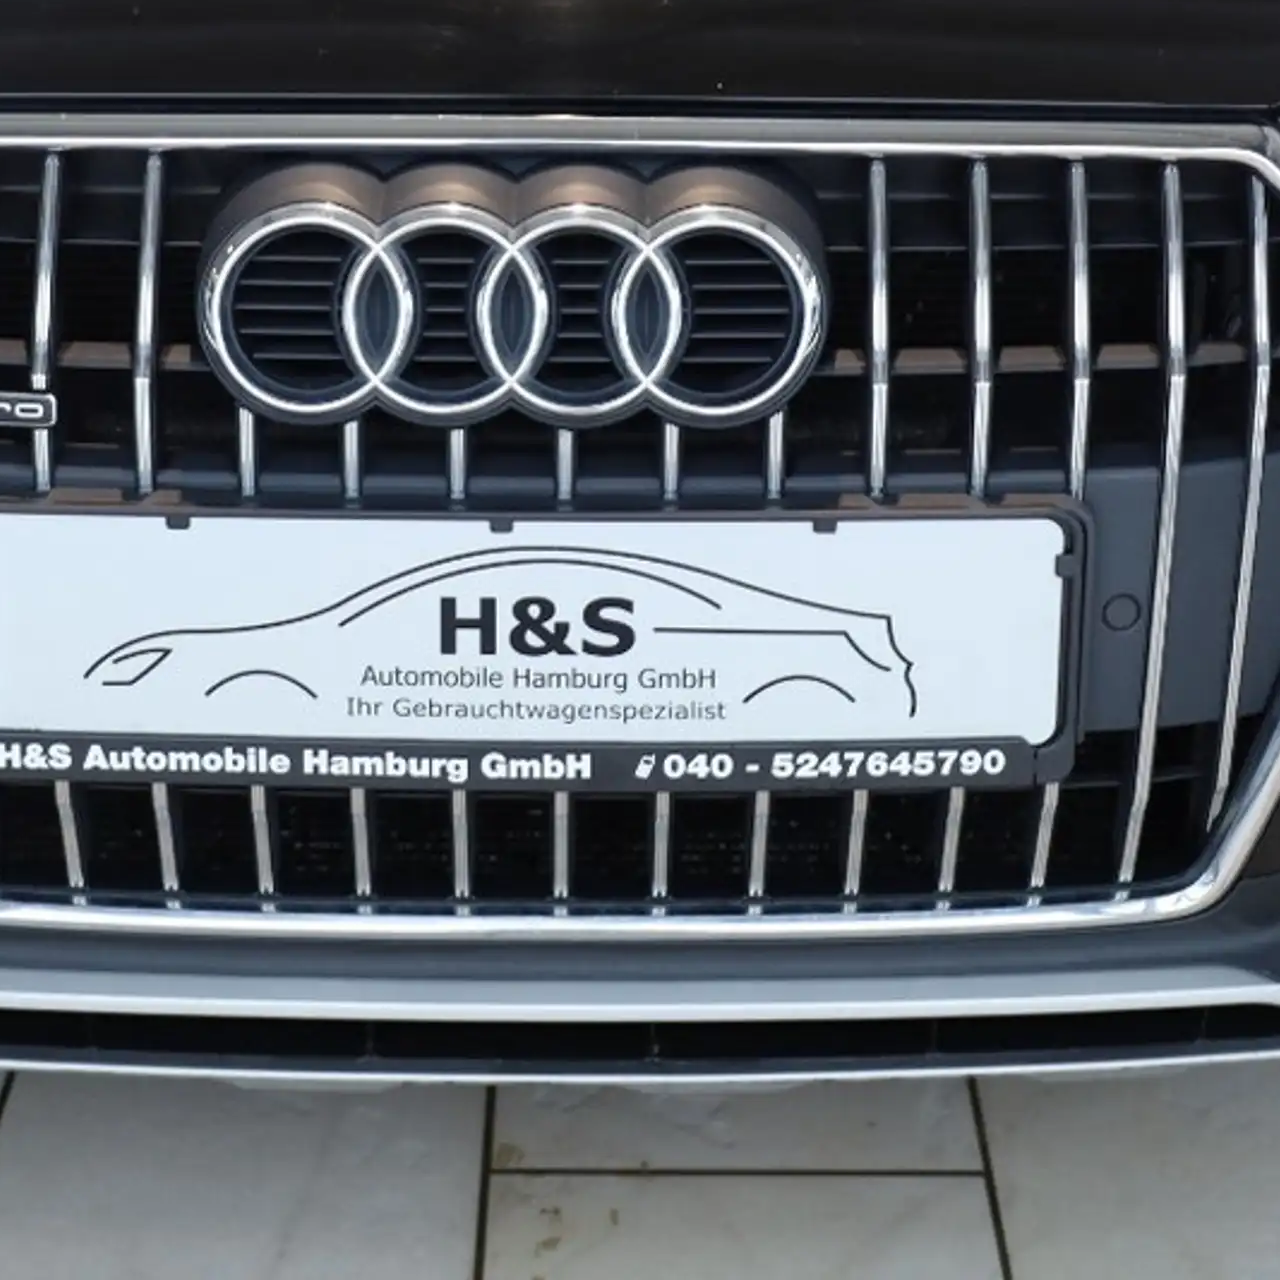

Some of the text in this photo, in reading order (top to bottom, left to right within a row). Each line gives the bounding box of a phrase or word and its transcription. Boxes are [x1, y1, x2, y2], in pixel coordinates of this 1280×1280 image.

[439, 595, 637, 659] H&S
[360, 665, 716, 694] Automobile Hamburg GmbH
[347, 696, 726, 725] Ihr Gebrauchtwagenspezialist
[82, 743, 291, 775] Automobile
[302, 747, 469, 784] Hamburg
[480, 751, 592, 780] GmbH
[662, 752, 734, 780] 040
[770, 748, 1007, 779] 5247645790
